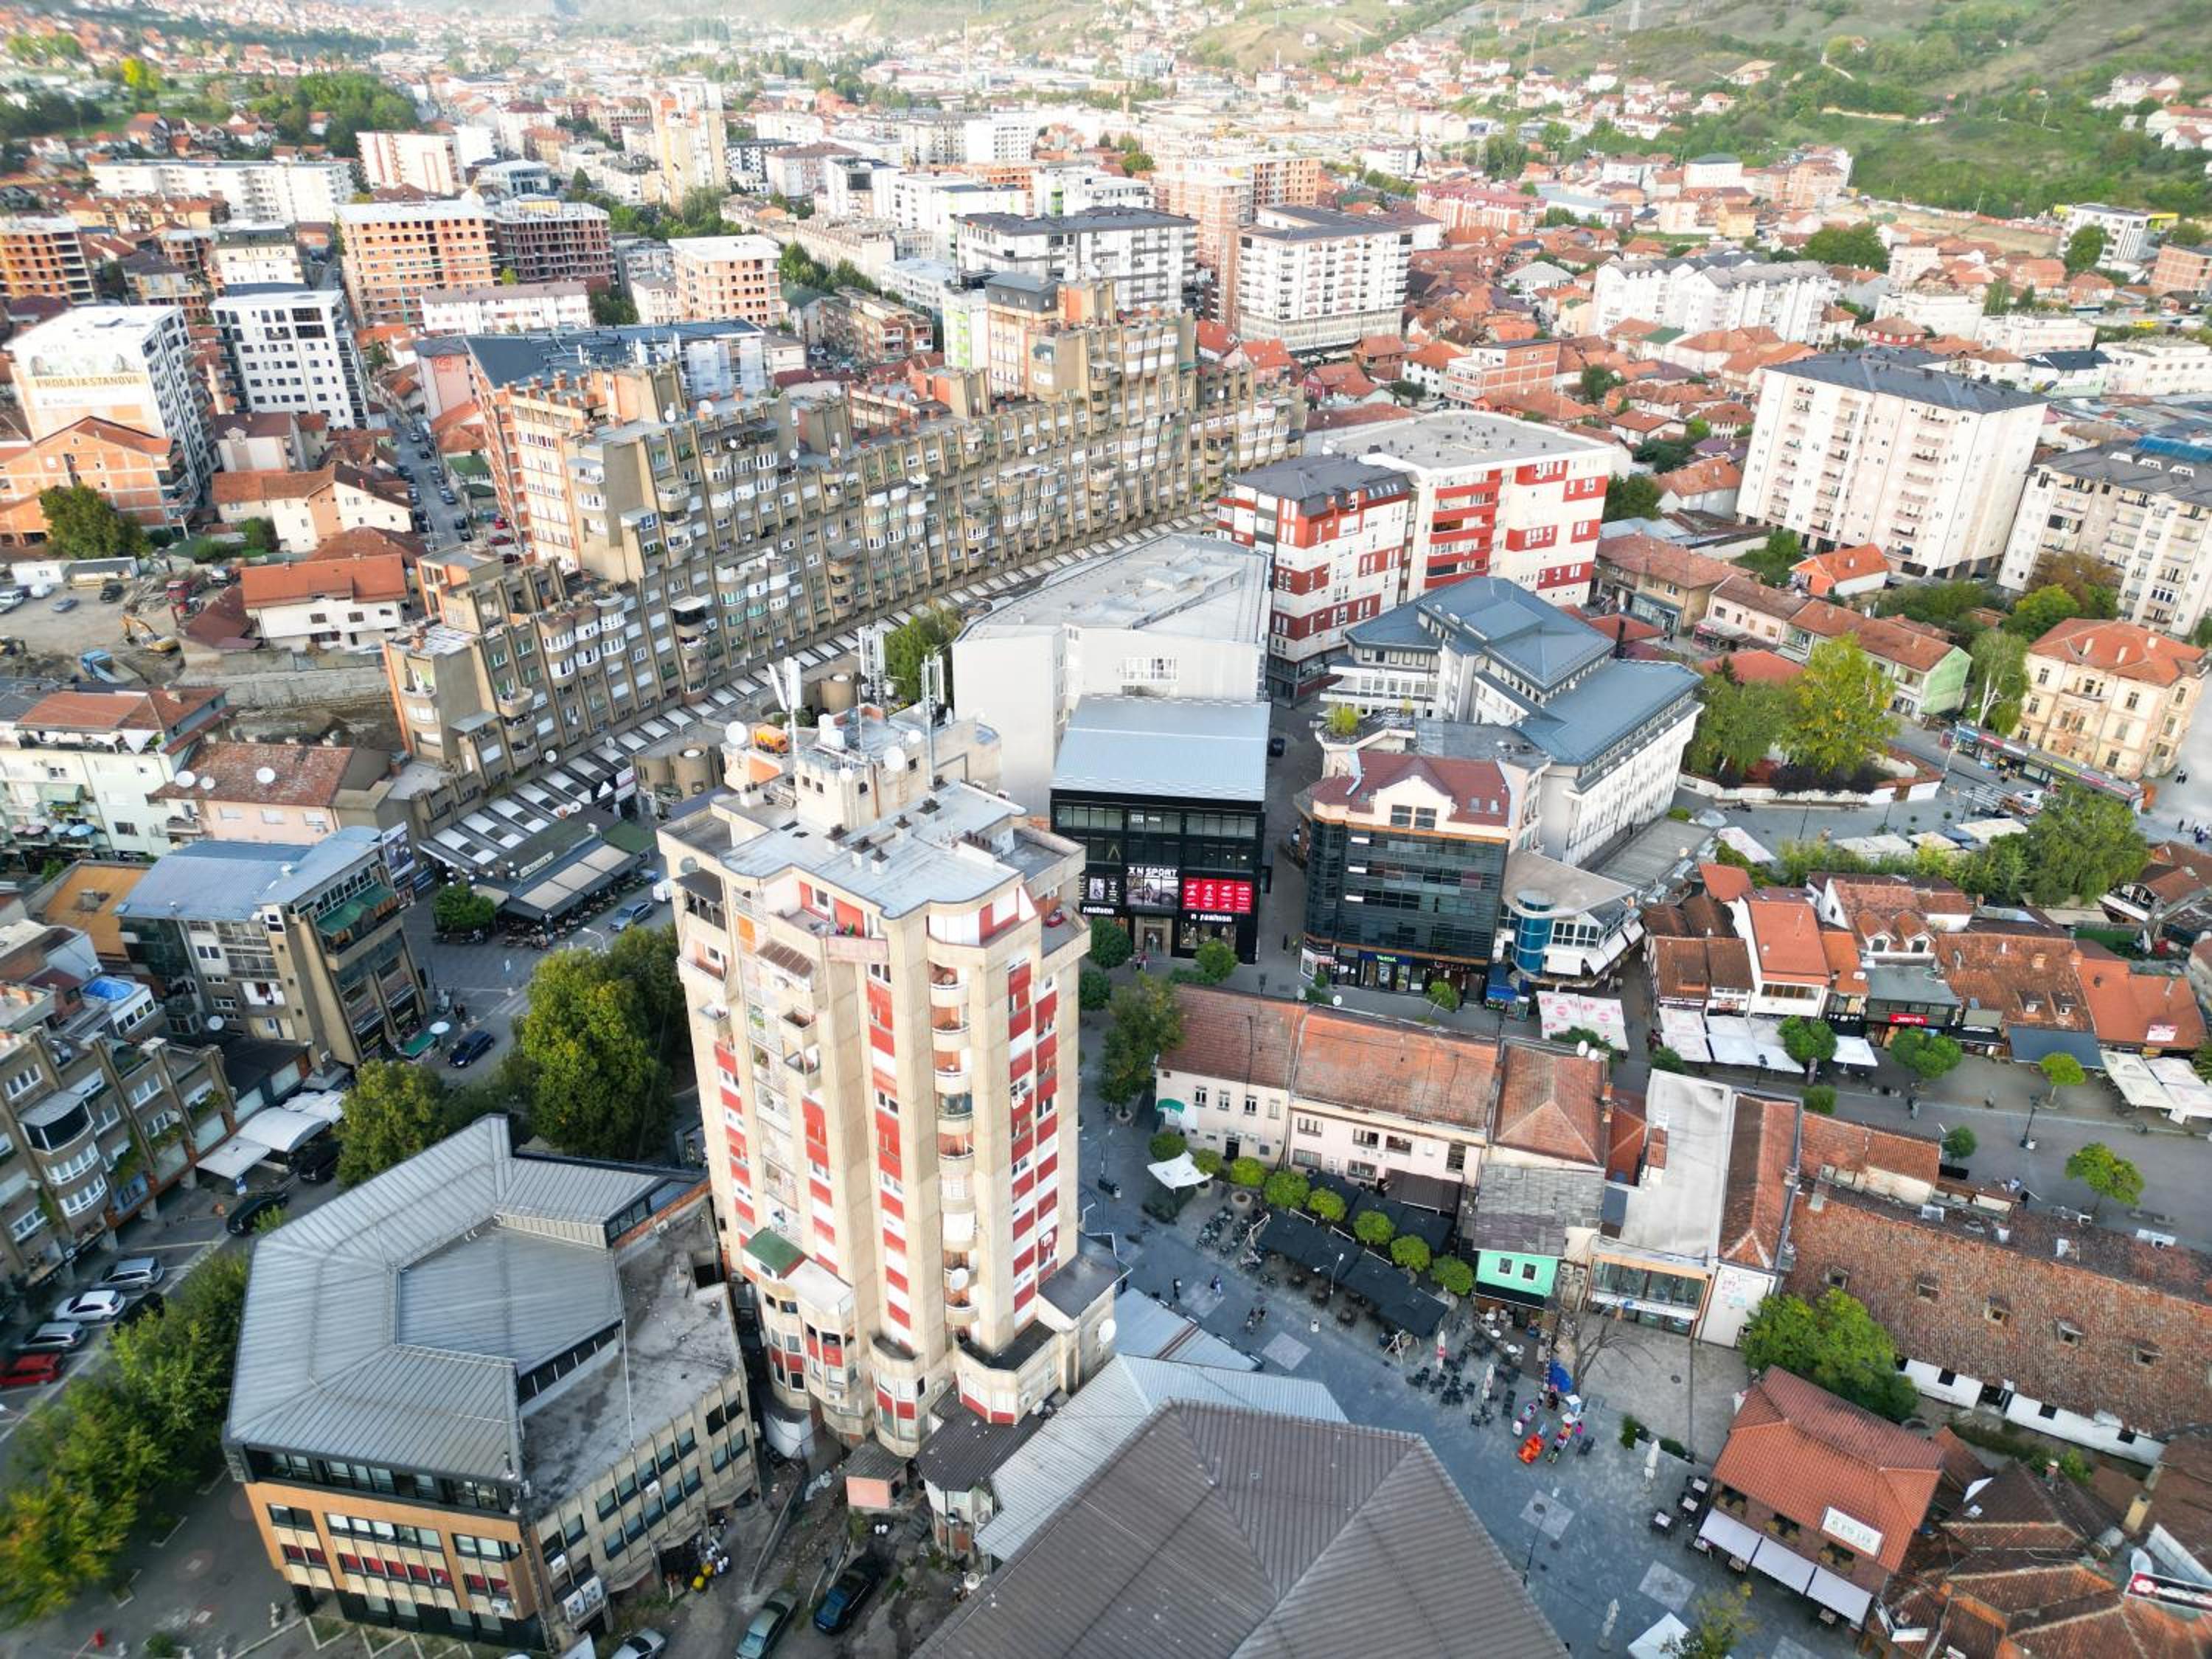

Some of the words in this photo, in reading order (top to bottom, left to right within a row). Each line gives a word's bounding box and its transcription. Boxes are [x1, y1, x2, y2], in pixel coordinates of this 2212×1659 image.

[35, 378, 88, 388] PRODAJA
[88, 375, 140, 386] STANOVA
[1145, 867, 1178, 877] SPORT
